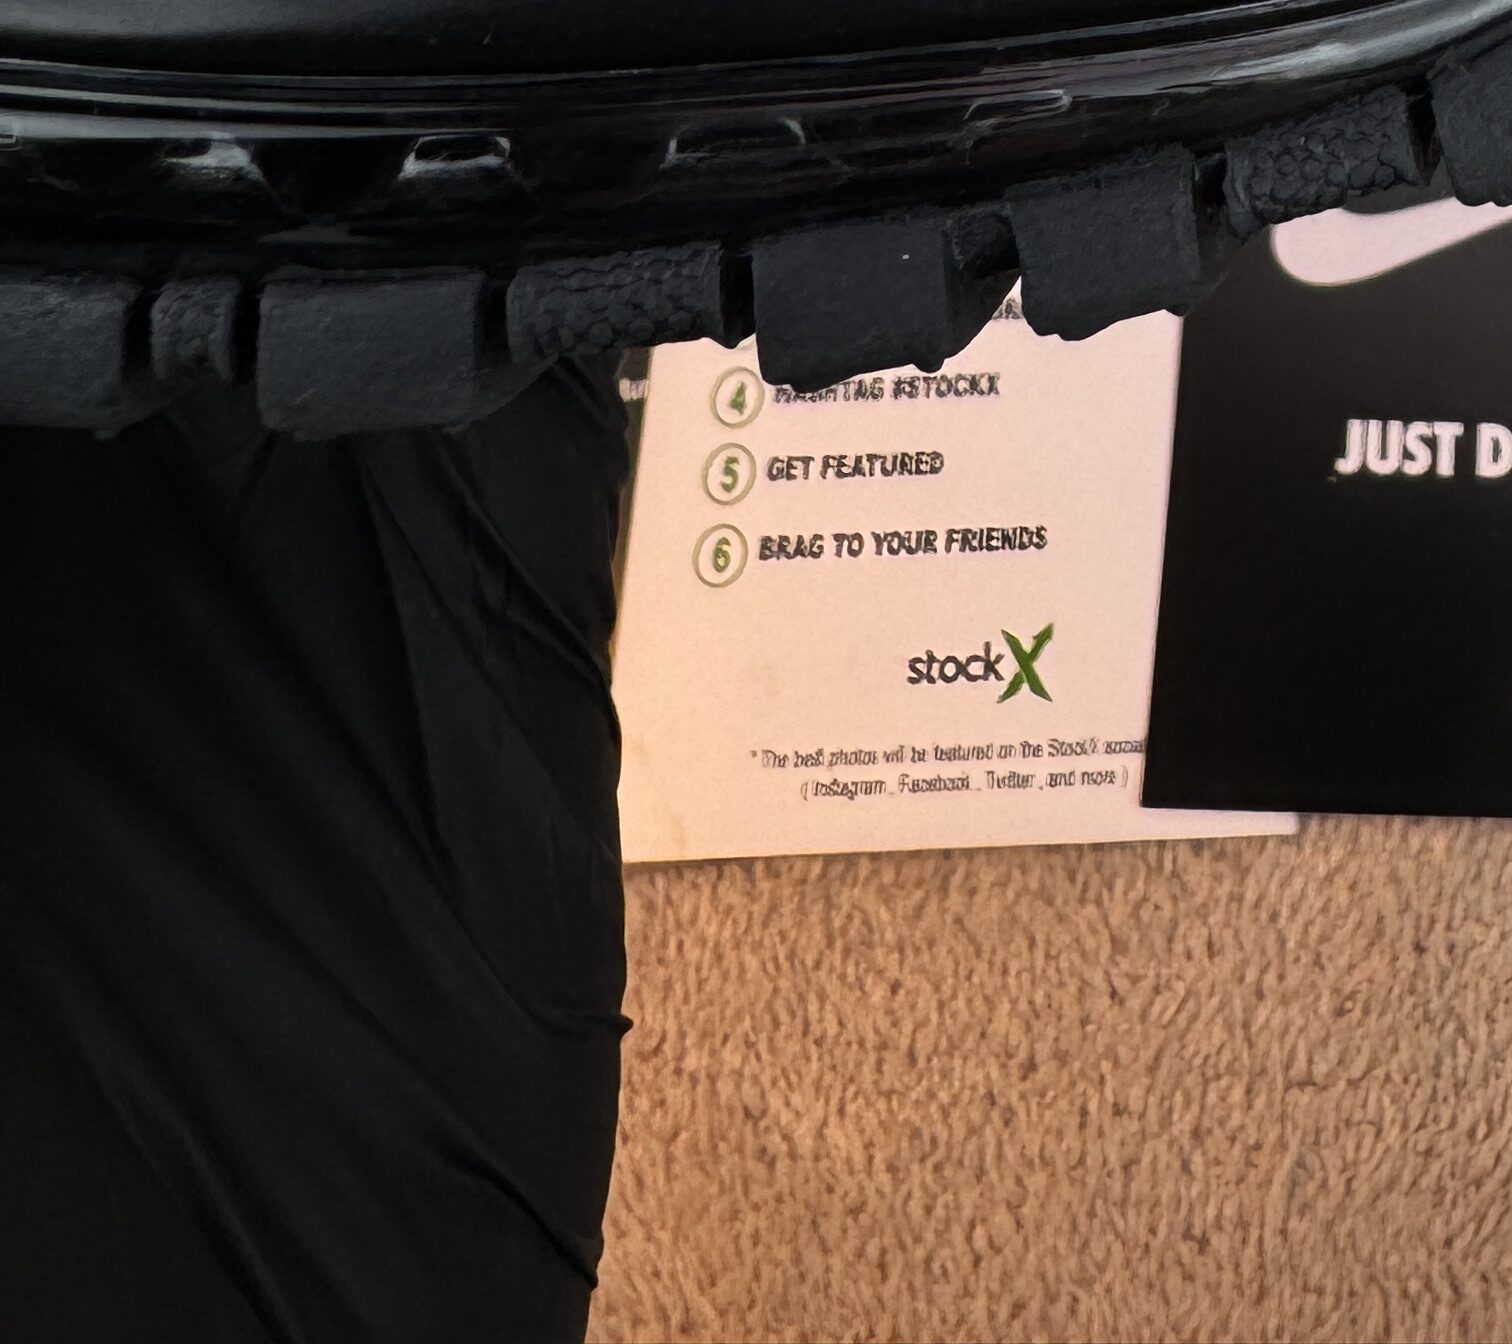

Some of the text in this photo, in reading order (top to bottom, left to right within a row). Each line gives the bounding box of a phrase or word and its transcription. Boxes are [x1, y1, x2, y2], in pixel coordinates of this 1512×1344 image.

[728, 380, 748, 416] 4
[893, 372, 1000, 401] #STOCKX
[1334, 418, 1464, 478] JUST
[719, 450, 945, 494] 5 GET FEATURED
[711, 524, 1049, 574] 6 BRAG TO YOUR FRIENDS
[828, 748, 879, 769] photos
[933, 742, 993, 761] featured
